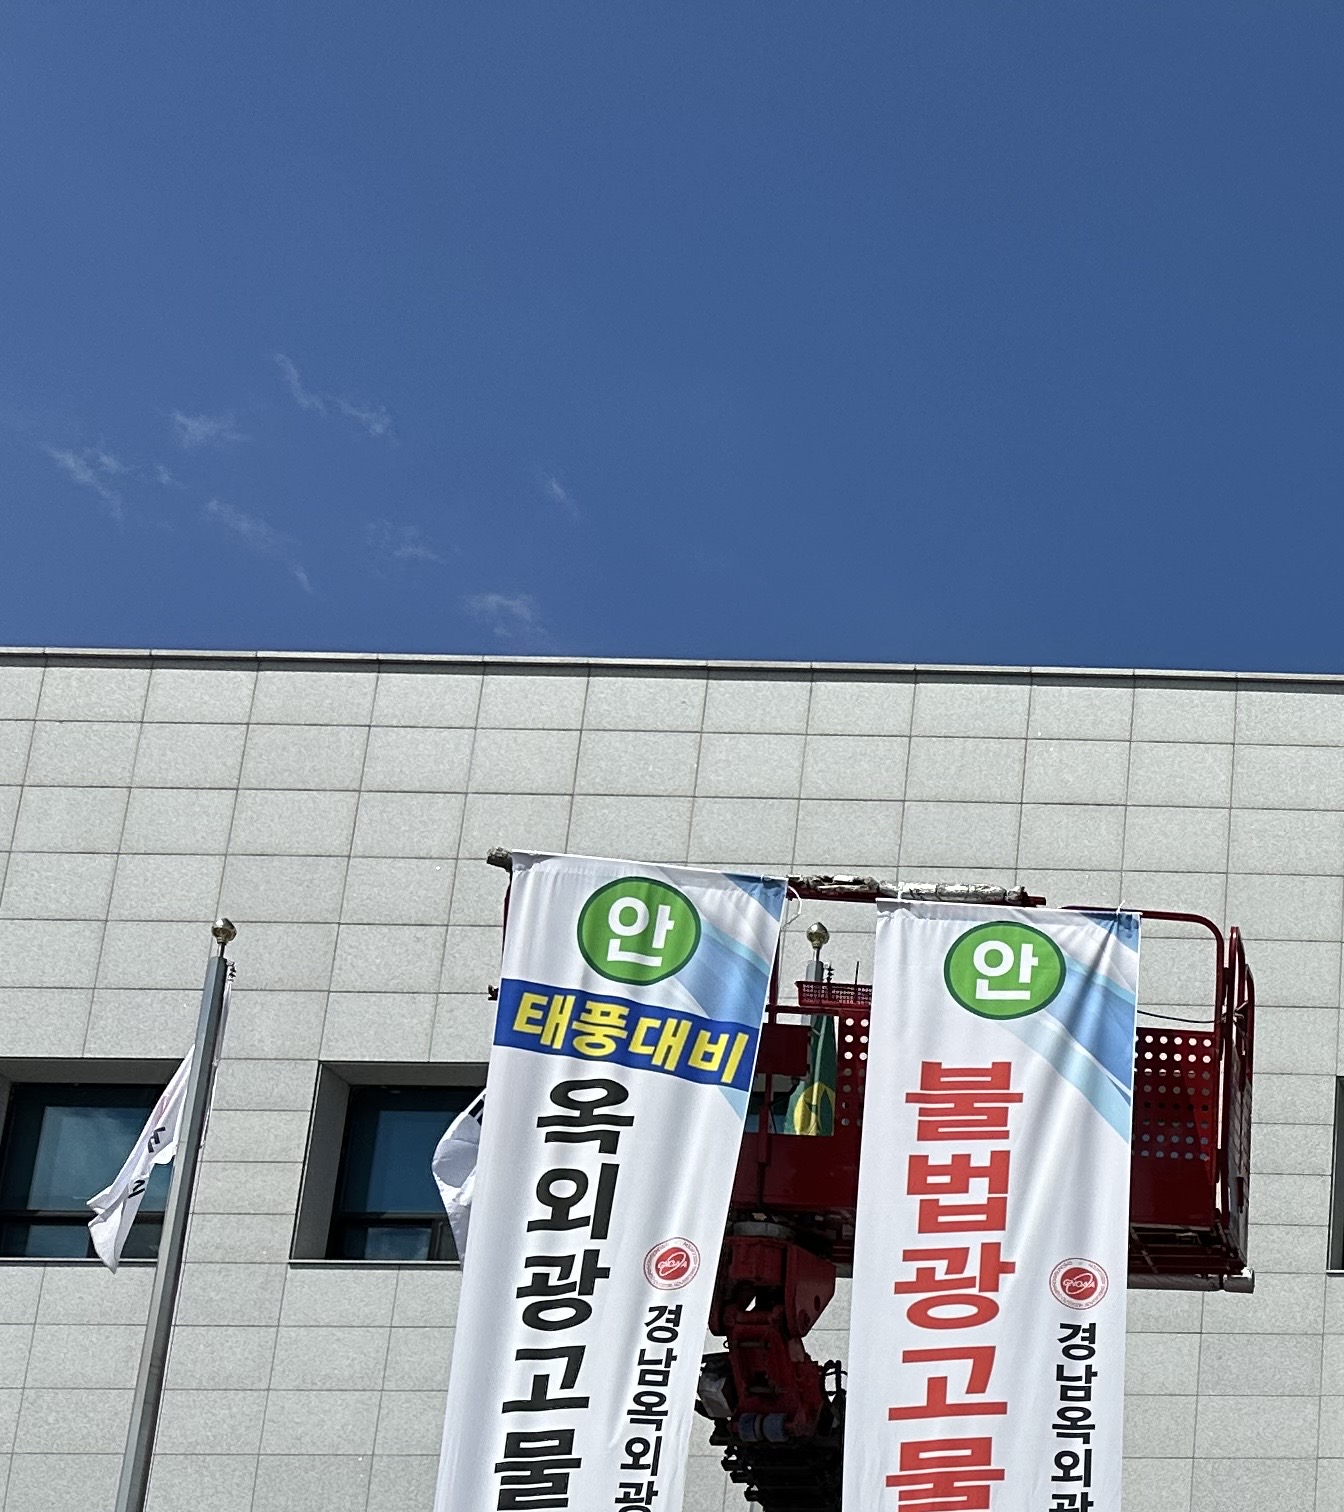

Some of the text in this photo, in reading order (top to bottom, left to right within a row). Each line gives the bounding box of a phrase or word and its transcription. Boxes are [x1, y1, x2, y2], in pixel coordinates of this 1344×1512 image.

[607, 897, 674, 966] 안
[974, 941, 1038, 1000] 안
[512, 993, 749, 1083] 태풍대비
[496, 1079, 634, 1512] 옥외광고물
